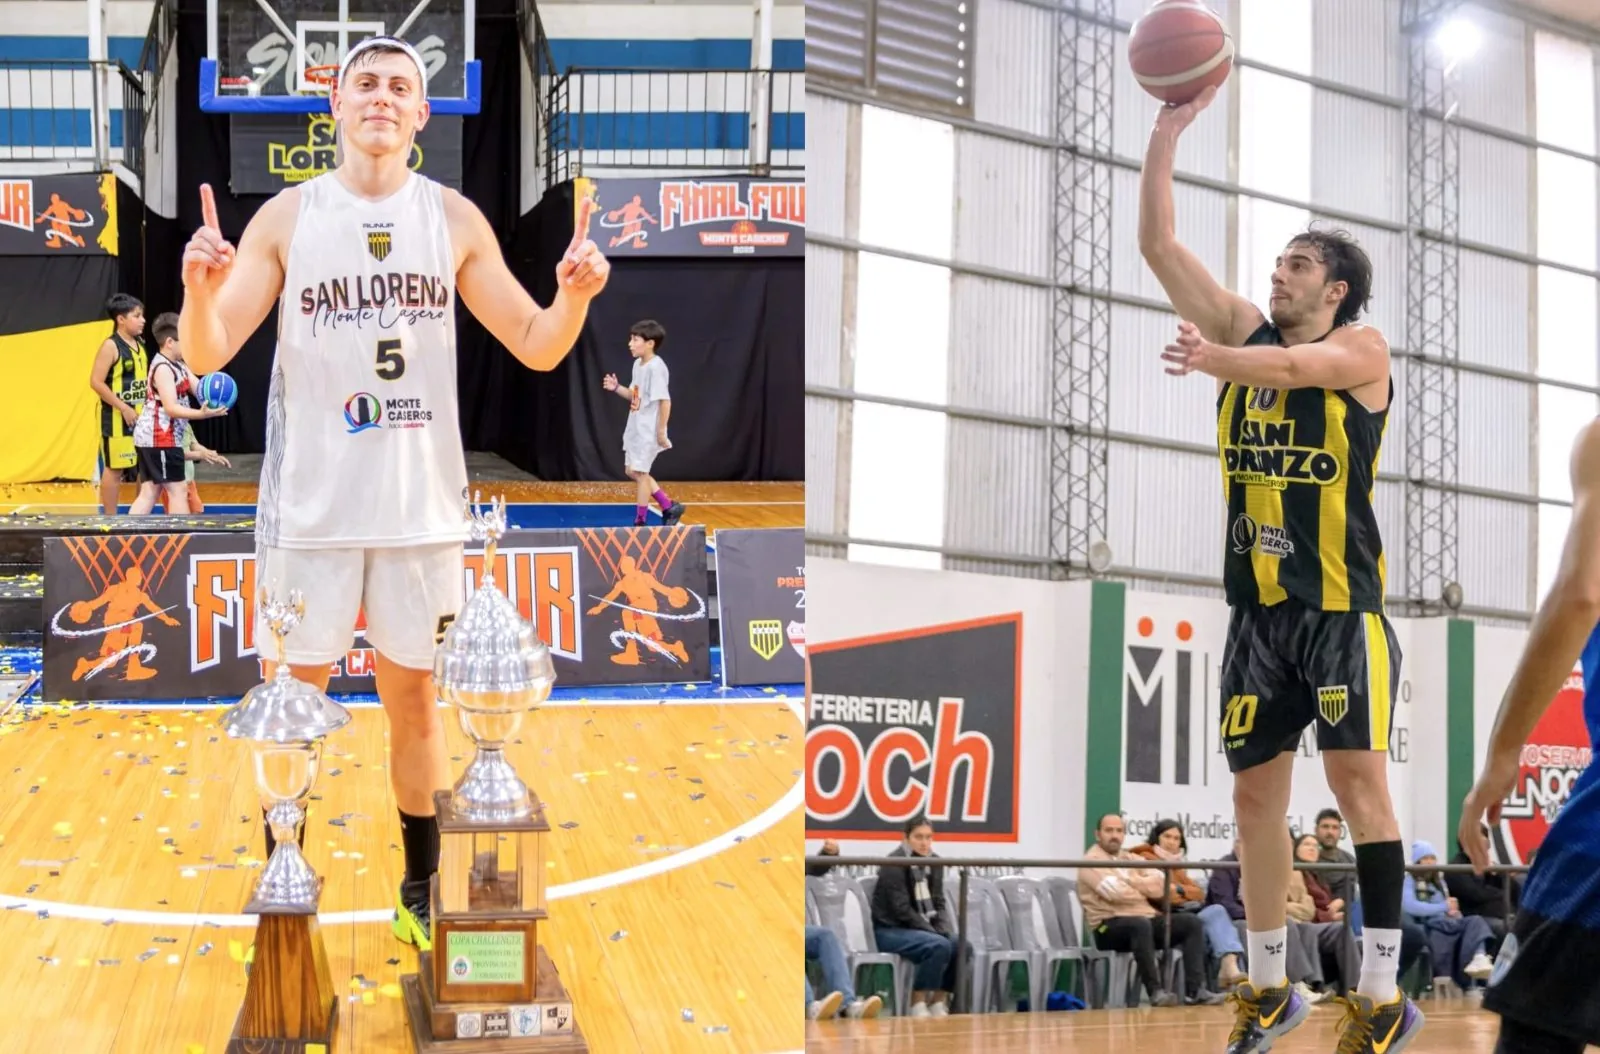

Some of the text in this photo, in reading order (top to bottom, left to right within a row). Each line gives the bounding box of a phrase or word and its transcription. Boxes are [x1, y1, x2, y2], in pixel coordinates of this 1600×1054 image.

[660, 180, 805, 232] FINAL FOU
[301, 276, 348, 316] SAN
[313, 297, 446, 338] Monte Casero
[376, 339, 405, 380] 5
[131, 381, 147, 391] SA
[386, 399, 421, 409] MONTE
[388, 411, 432, 421] CASEROS
[1240, 419, 1293, 447] SAN
[777, 577, 805, 588] PRE
[463, 546, 582, 662] OUR
[810, 694, 934, 726] FERRETERIA
[1221, 695, 1258, 737] 10
[1176, 812, 1238, 840] Mendiet
